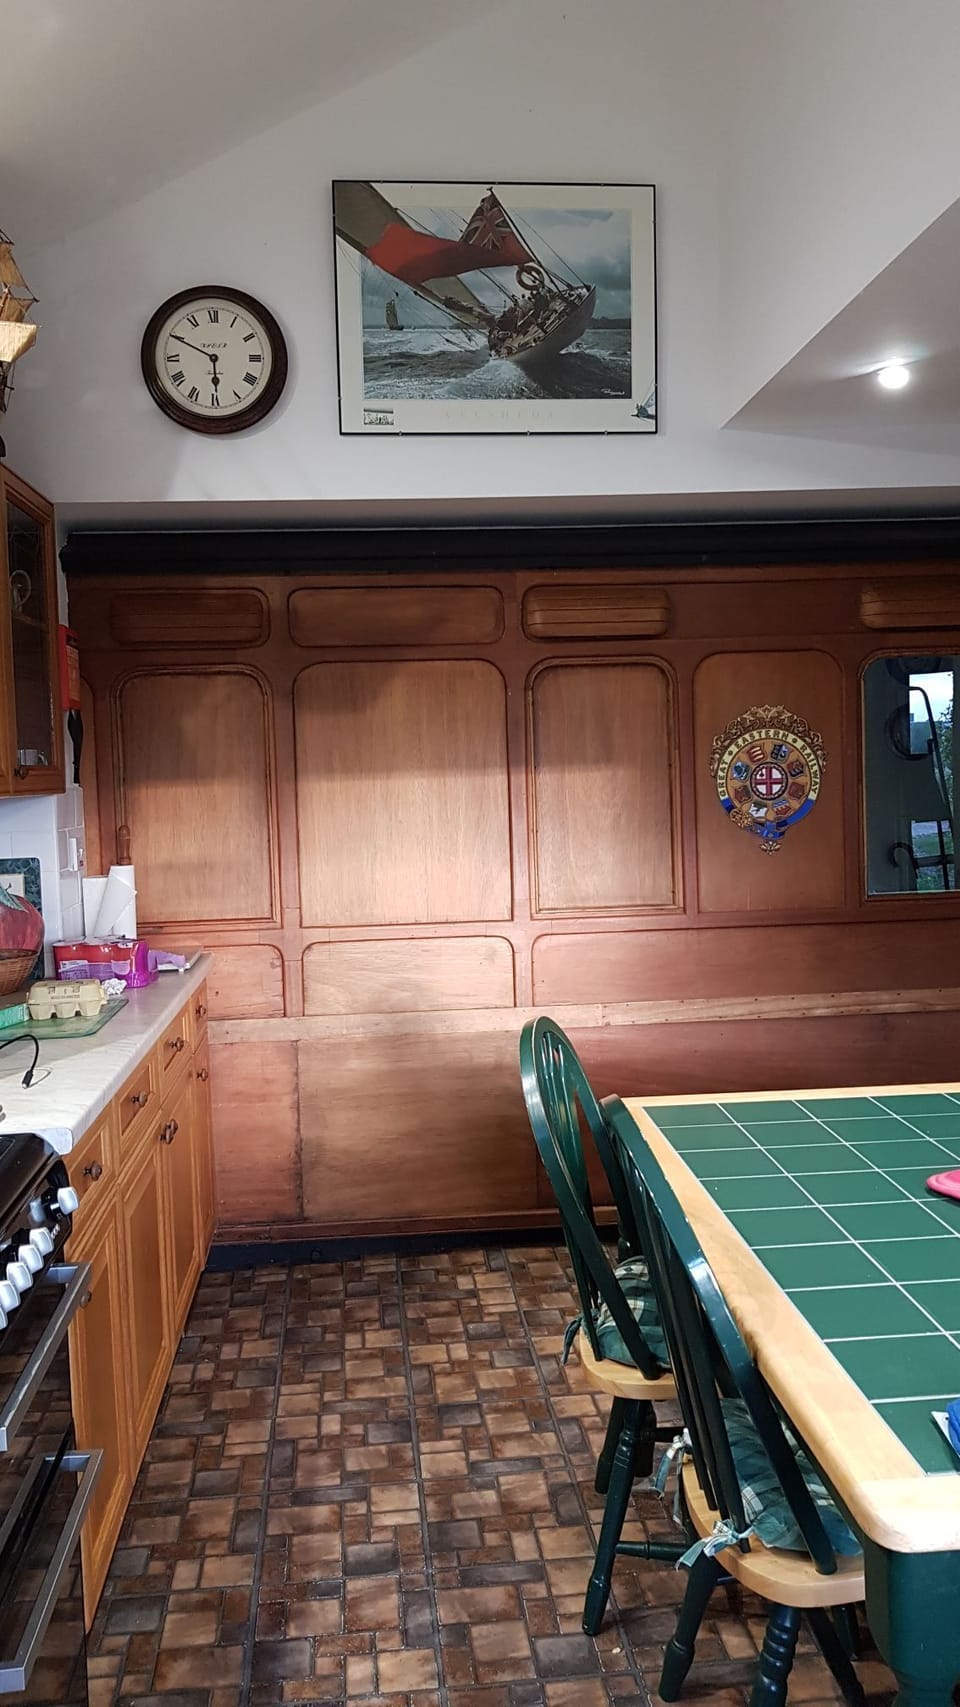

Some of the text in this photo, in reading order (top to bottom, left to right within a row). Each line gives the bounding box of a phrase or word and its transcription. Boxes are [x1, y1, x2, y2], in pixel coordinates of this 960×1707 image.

[229, 316, 238, 328] I
[242, 332, 256, 343] II
[248, 354, 262, 363] III
[718, 730, 819, 797] GREAT EASTERN RAILWAY
